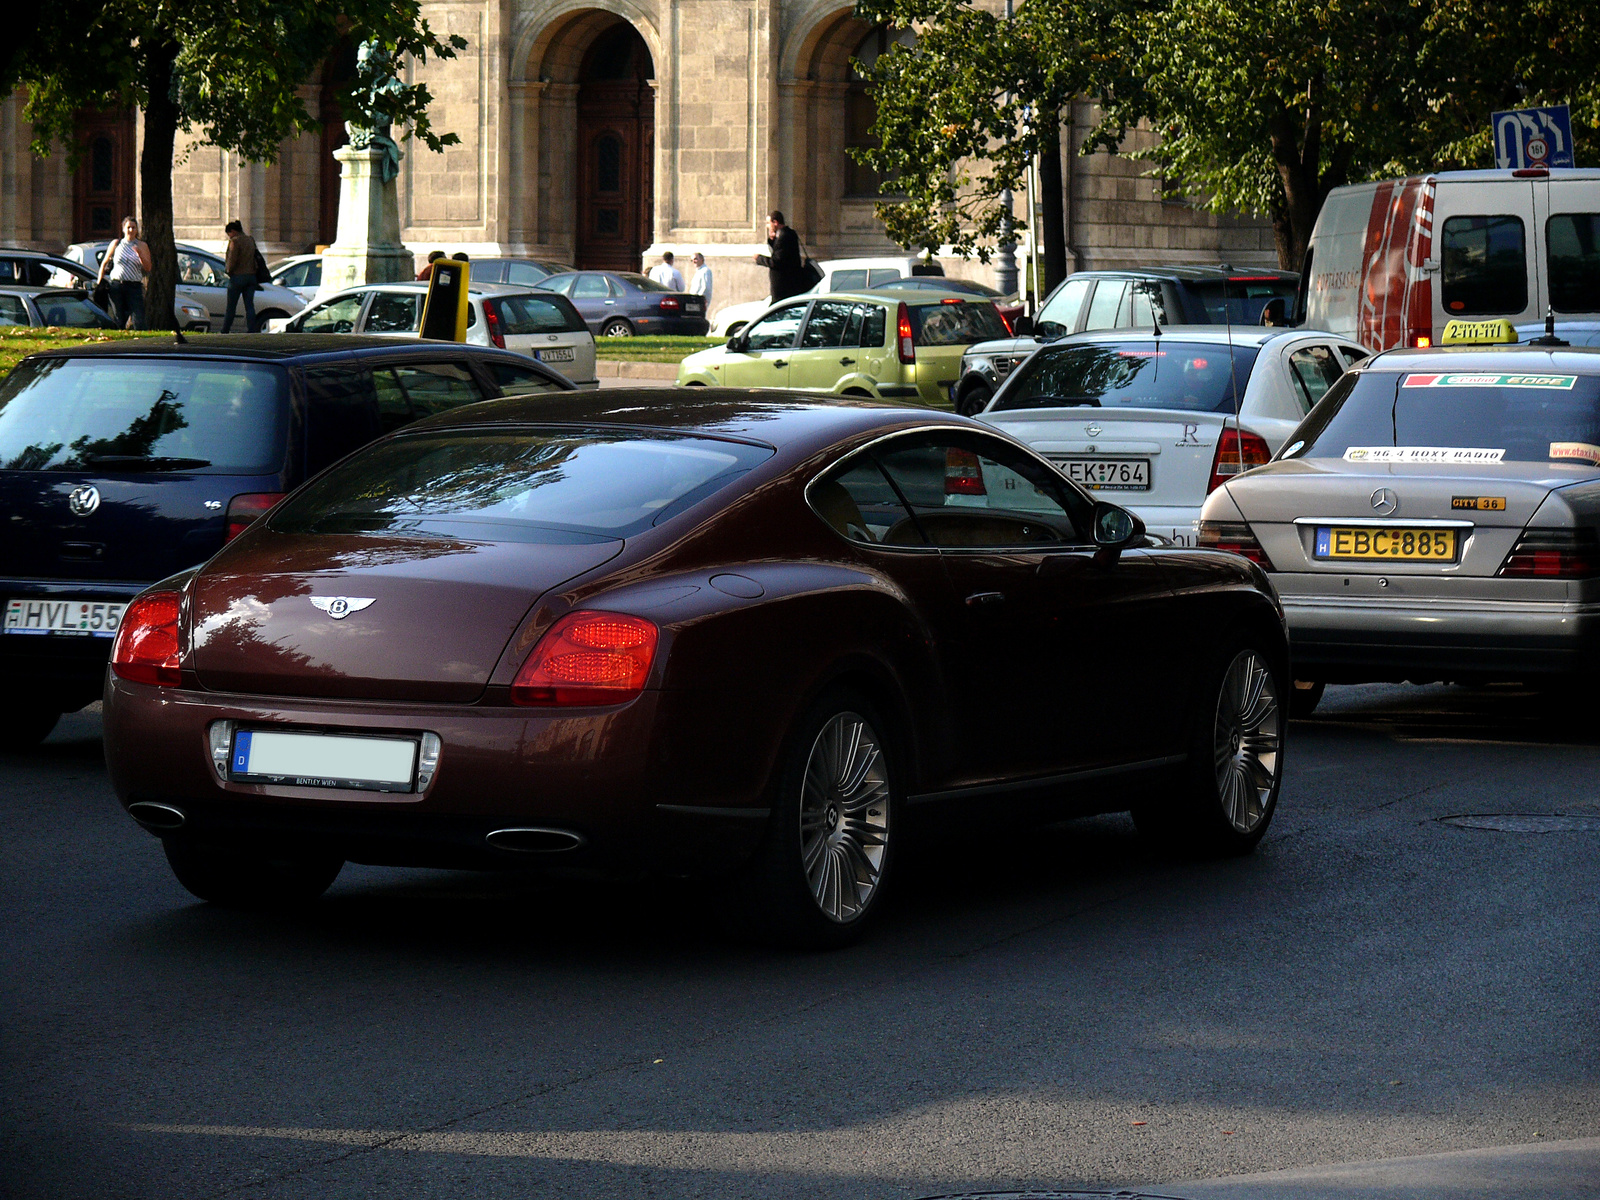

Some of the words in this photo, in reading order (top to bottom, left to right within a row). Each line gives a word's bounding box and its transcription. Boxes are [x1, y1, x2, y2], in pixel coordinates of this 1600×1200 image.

[1451, 324, 1501, 338] 2-111-111
[1506, 376, 1566, 386] EDGE
[1454, 451, 1499, 459] RADIO
[1452, 498, 1476, 507] CITY
[1483, 499, 1498, 509] 36
[1319, 543, 1327, 553] H
[8, 614, 18, 626] H
[237, 755, 245, 766] D
[296, 777, 320, 786] BENTLEY
[321, 779, 337, 787] WIEN
